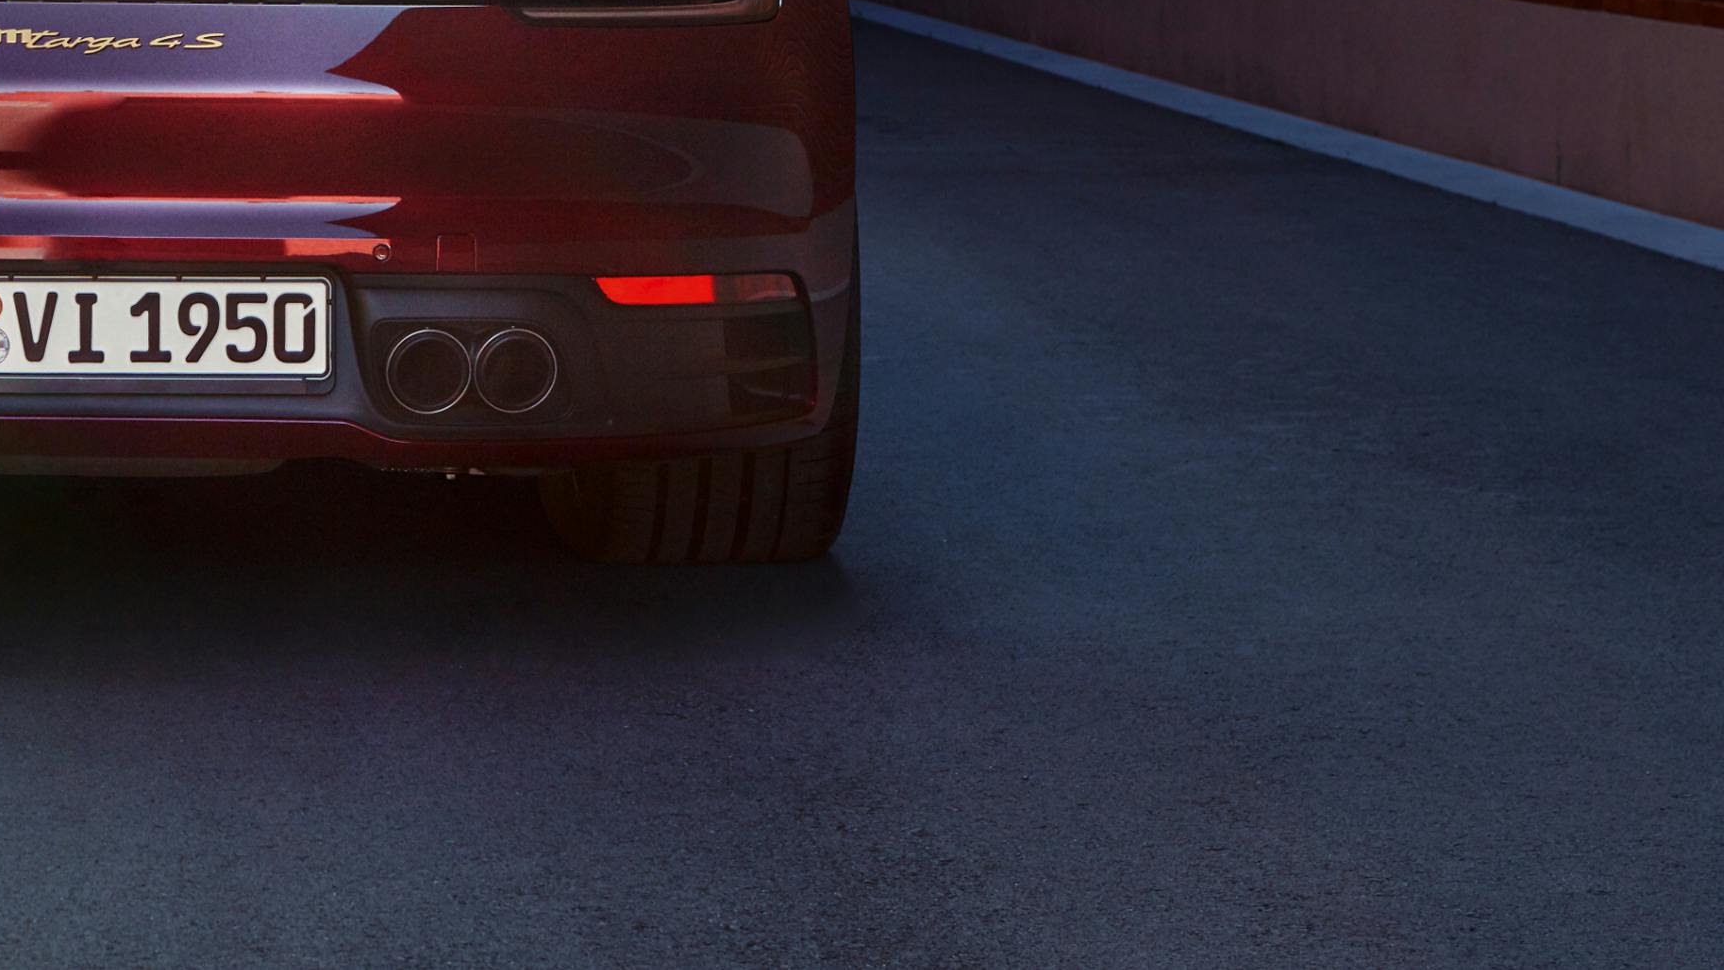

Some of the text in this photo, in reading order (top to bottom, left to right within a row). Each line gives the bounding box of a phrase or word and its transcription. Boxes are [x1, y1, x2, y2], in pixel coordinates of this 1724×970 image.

[26, 30, 141, 55] targa
[13, 291, 105, 363] VI
[129, 291, 316, 364] 1950
